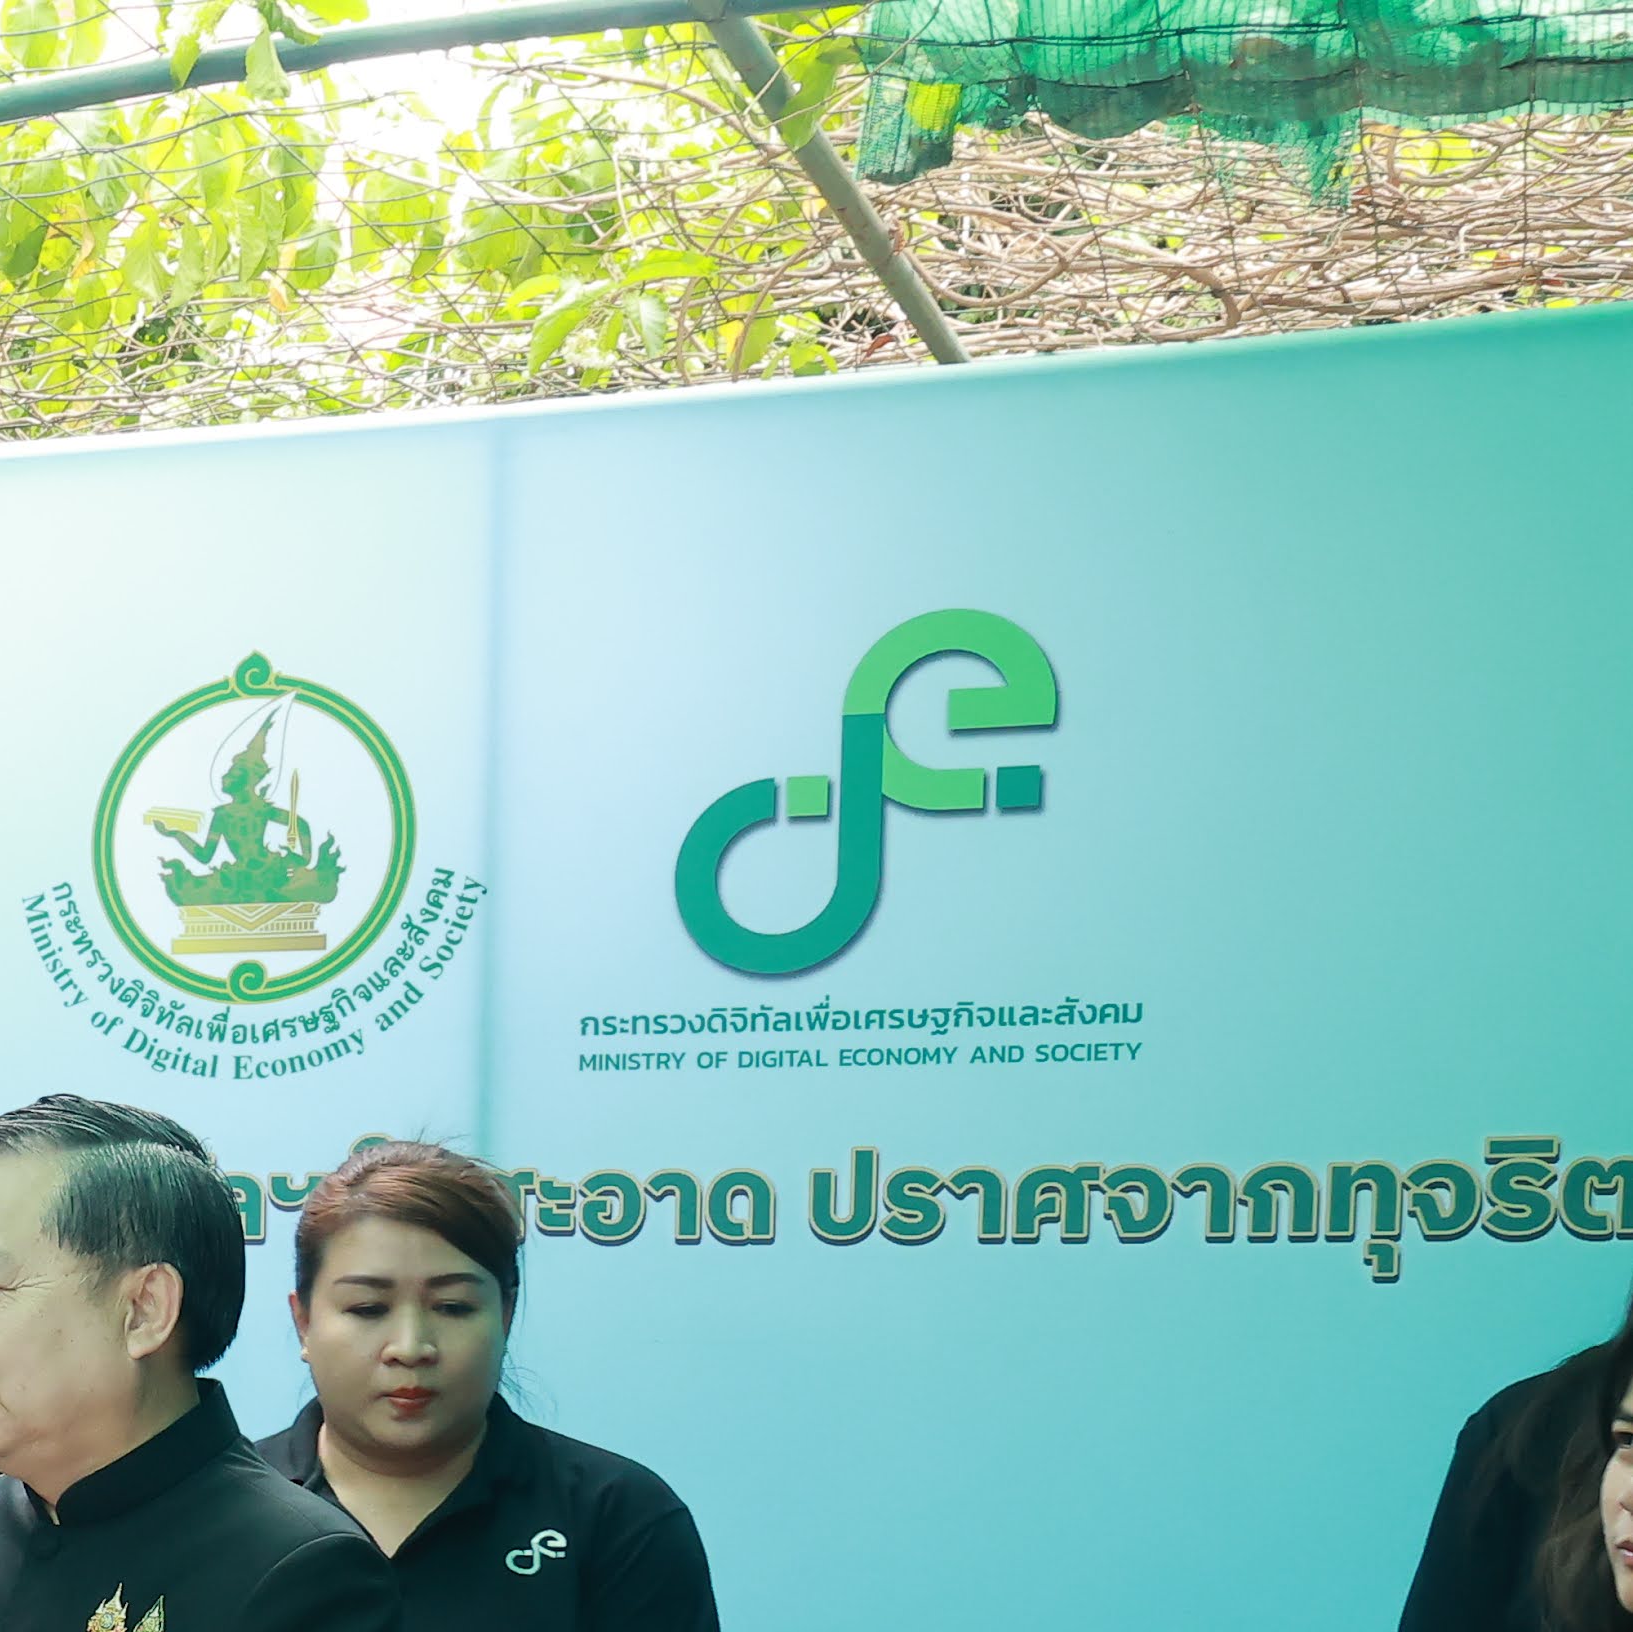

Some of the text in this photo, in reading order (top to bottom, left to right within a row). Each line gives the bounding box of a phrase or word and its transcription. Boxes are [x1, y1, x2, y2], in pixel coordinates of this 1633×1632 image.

[22, 876, 488, 1080] Ministry of Digital Economy and Society
[52, 867, 455, 1045] กระทรวงดิจิทัลเพื่อเศรษฐกิจและสังคม
[579, 1042, 1142, 1072] MINISTRY OF DIGITAL ECONOMY AND SOCIETY
[580, 995, 1144, 1036] กระทรวงดิจิทัลเพื่อเศรษฐกิจและสังคม
